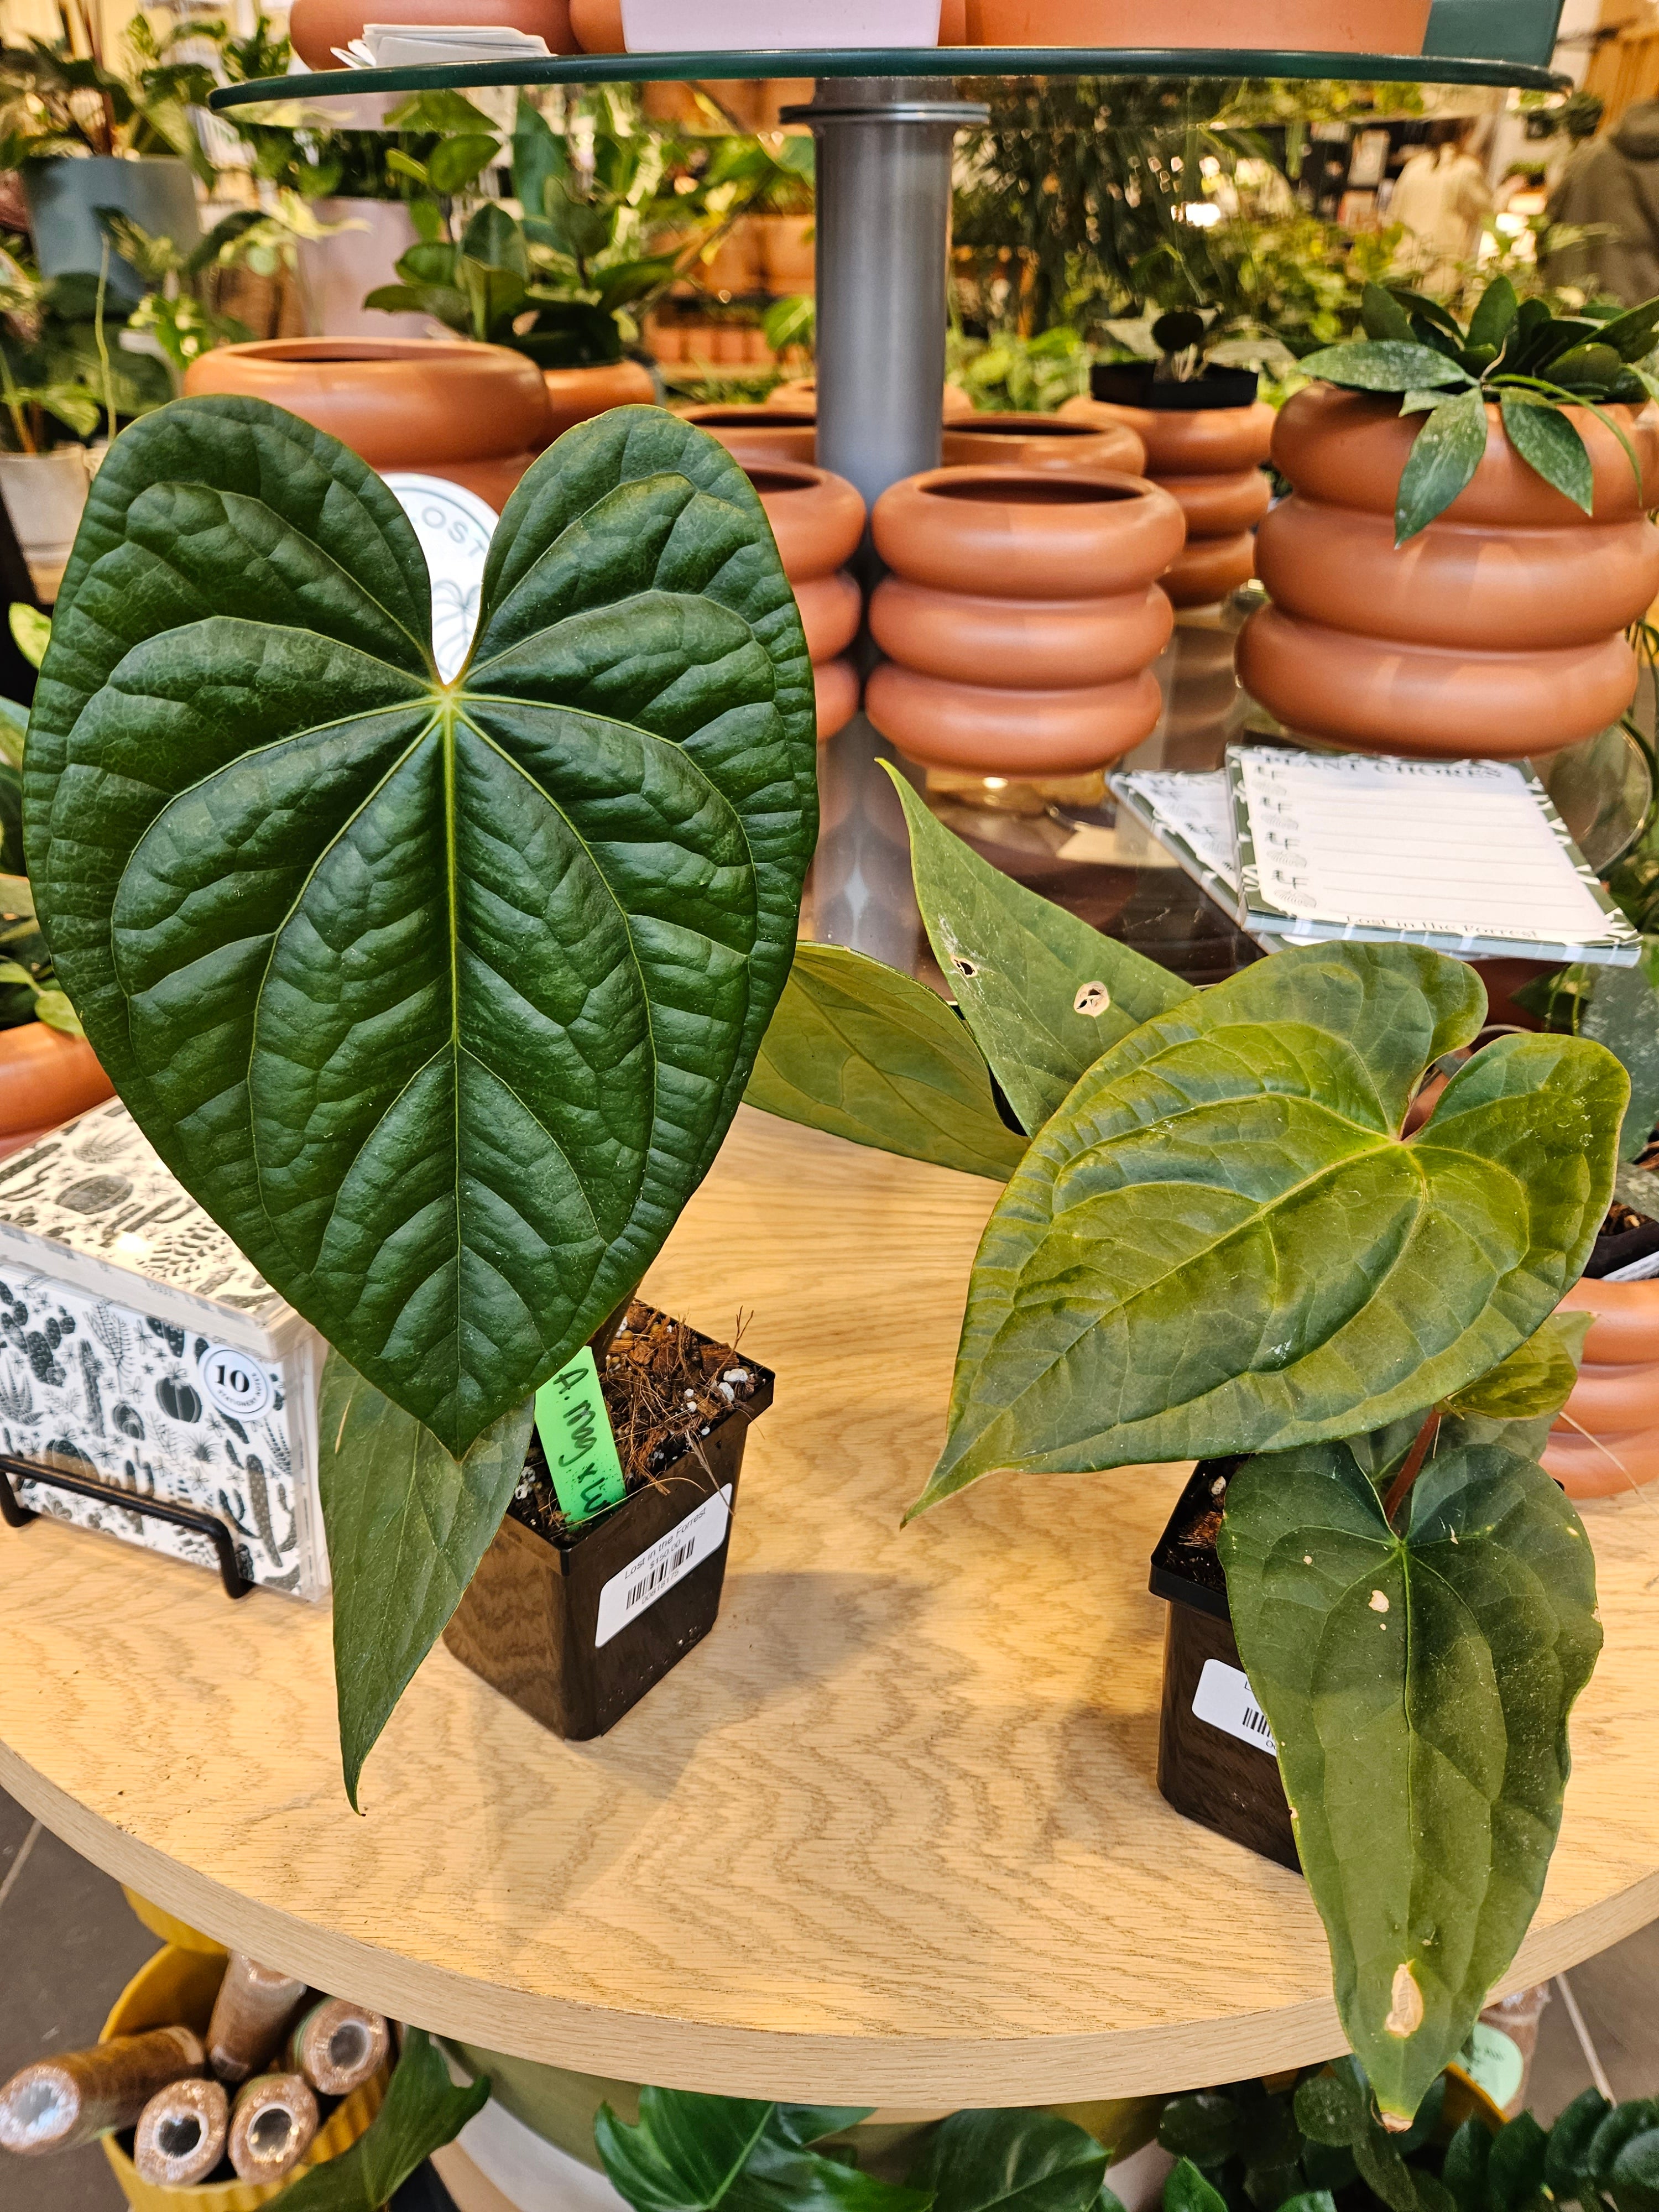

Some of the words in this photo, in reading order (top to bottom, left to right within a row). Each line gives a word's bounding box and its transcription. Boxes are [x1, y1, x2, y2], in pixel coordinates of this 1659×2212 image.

[1347, 915, 1387, 926] Lost
[1397, 922, 1415, 930] in
[1422, 922, 1456, 931] the
[215, 1365, 249, 1392] 10
[553, 1368, 589, 1401] A.
[624, 1557, 645, 1580] Lost
[648, 1550, 656, 1561] in
[659, 1536, 673, 1552] the
[676, 1507, 706, 1537] Forrest
[649, 1539, 681, 1570] $150.00
